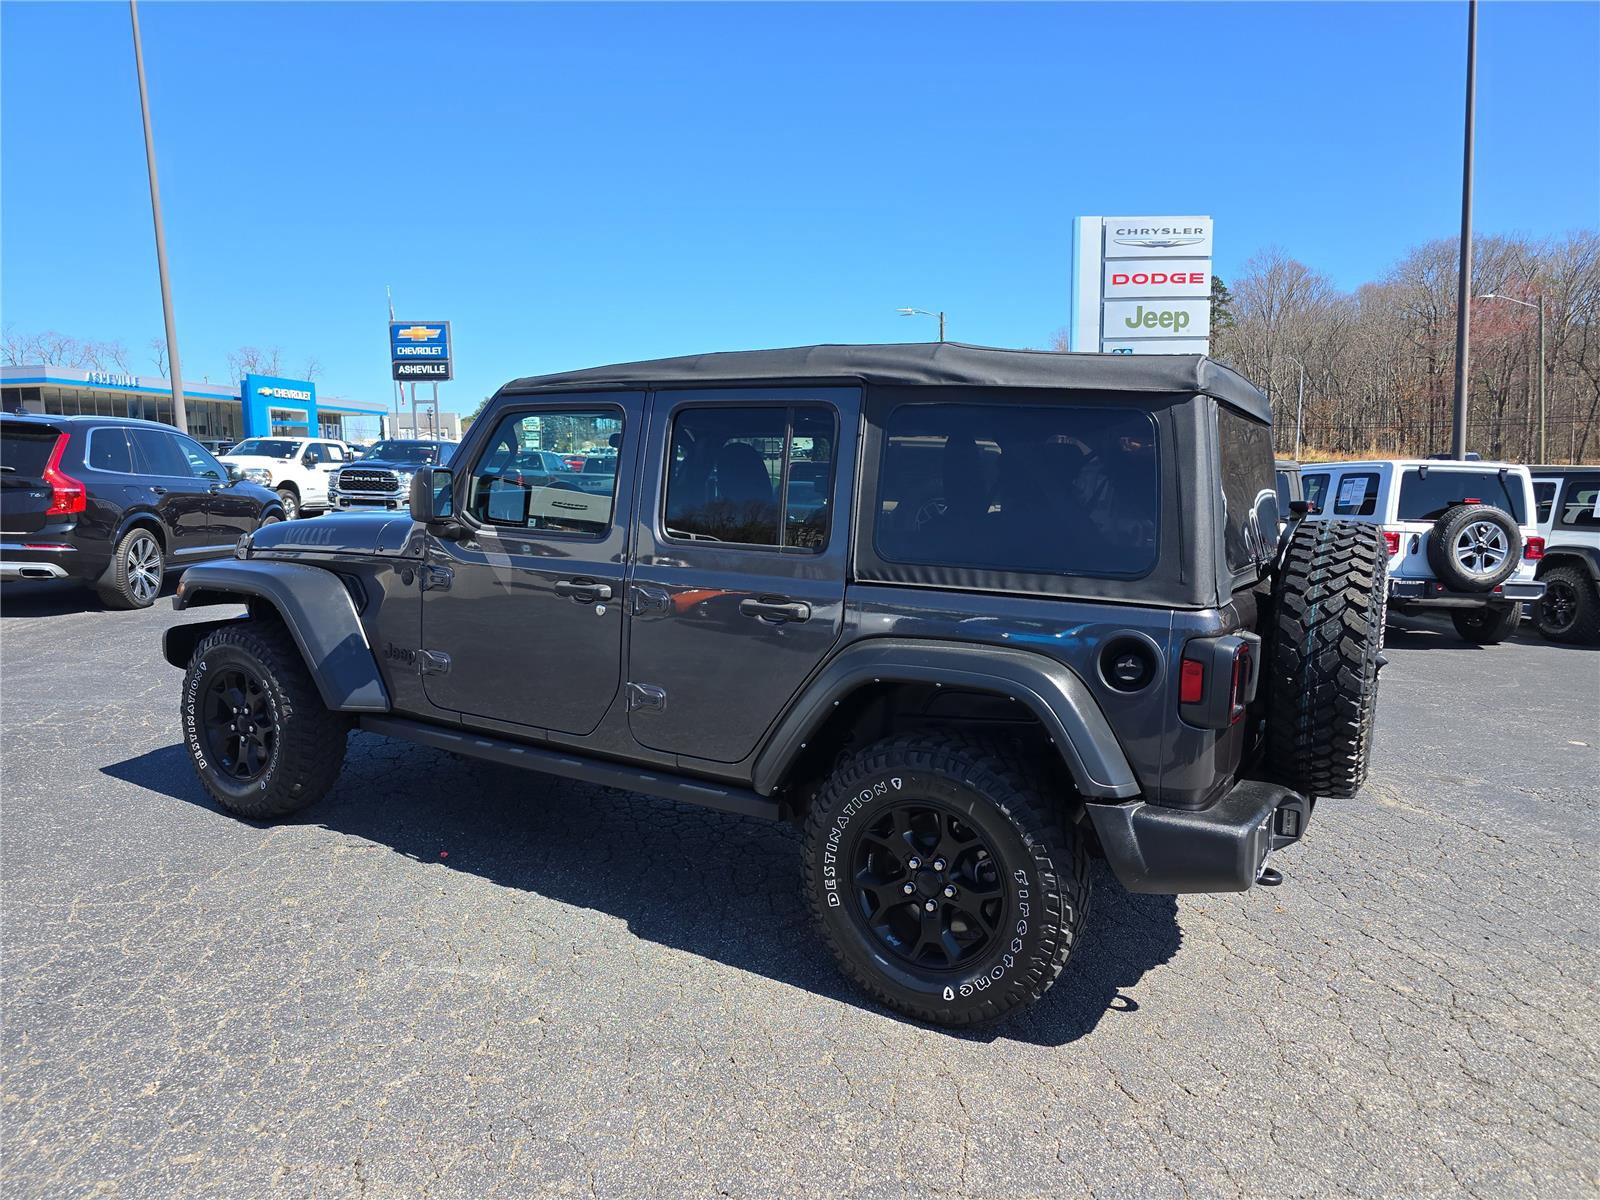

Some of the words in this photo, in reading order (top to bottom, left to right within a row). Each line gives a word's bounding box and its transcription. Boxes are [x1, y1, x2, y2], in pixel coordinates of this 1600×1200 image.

[1116, 227, 1204, 235] CHRYSLER
[1112, 272, 1205, 285] DODGE
[1125, 305, 1190, 332] Jeep
[397, 346, 443, 355] CHEVROLET
[398, 365, 446, 374] ASHEVILLE
[86, 372, 140, 387] ASHEVILLE
[273, 388, 312, 401] CHEVROLET
[283, 527, 337, 545] WILLYS
[384, 642, 417, 666] Jeep
[186, 669, 208, 769] DESTINATION
[824, 781, 888, 907] DESTINATION
[960, 870, 1030, 997] Firestone
